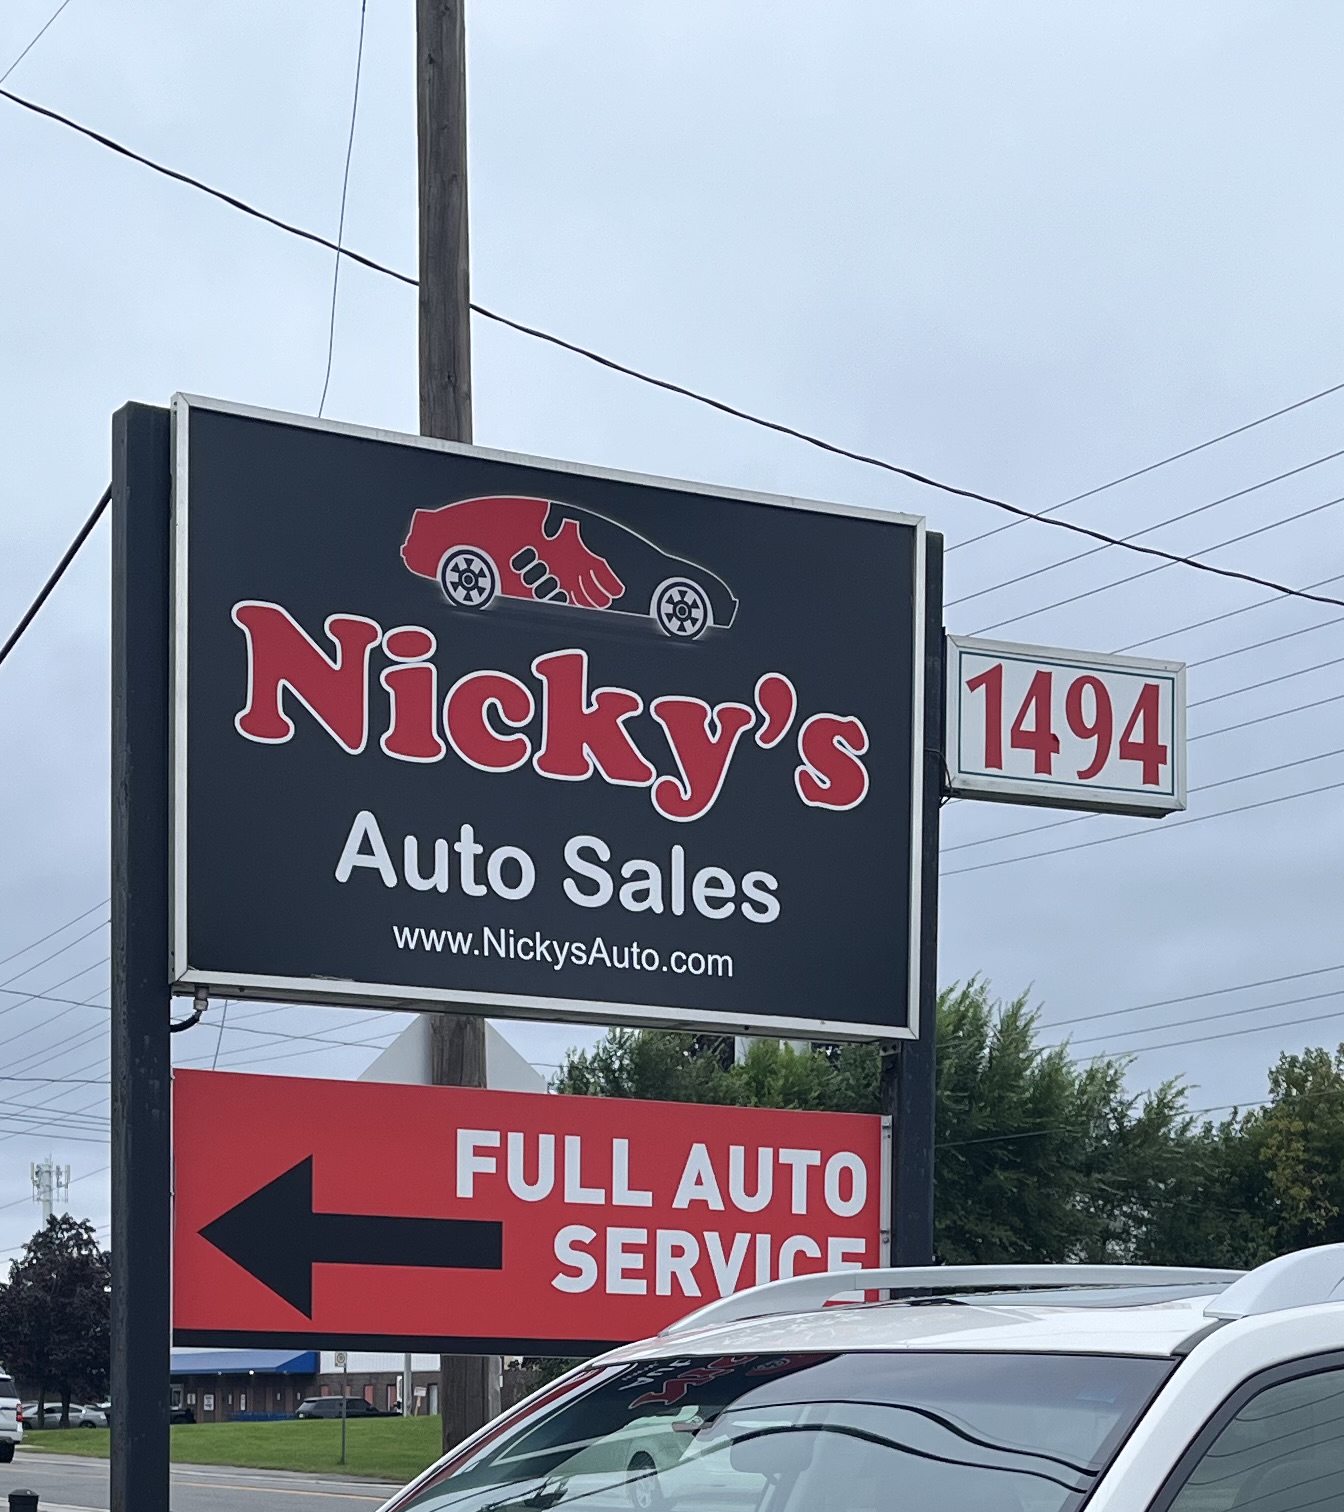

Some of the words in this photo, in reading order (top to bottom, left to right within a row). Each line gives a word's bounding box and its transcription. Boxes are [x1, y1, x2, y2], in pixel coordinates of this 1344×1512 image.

[231, 599, 870, 822] Nicky's
[965, 663, 1168, 786] 1494
[335, 811, 536, 900] Auto
[563, 836, 781, 923] Sales
[392, 925, 733, 977] www.NickysAuto.com
[456, 1128, 653, 1208] FULL
[671, 1142, 868, 1218] AUTO
[550, 1224, 867, 1303] SERVICE
